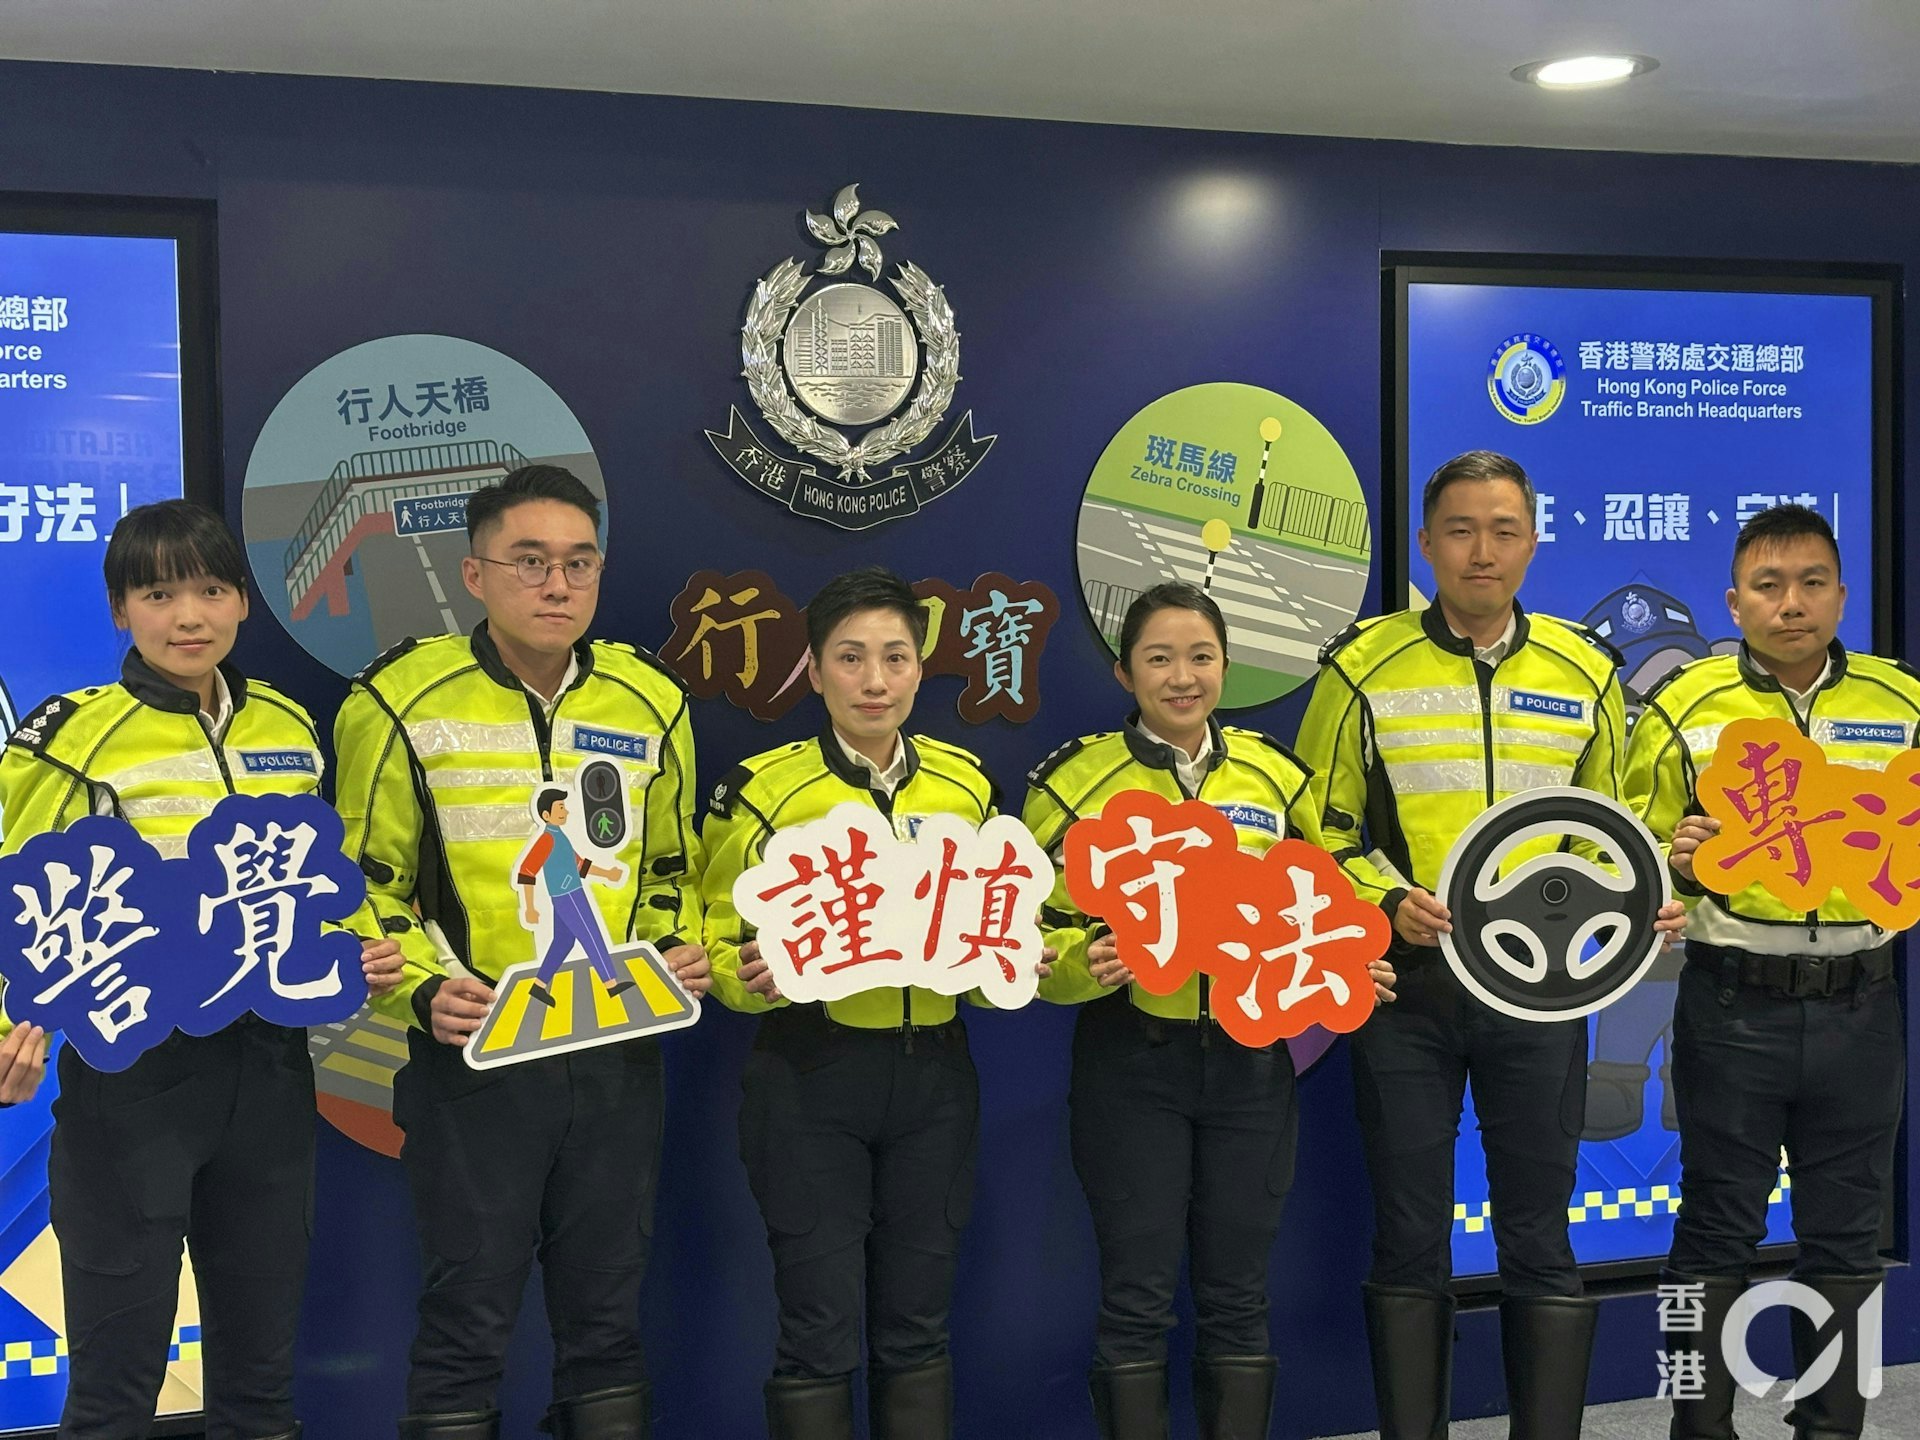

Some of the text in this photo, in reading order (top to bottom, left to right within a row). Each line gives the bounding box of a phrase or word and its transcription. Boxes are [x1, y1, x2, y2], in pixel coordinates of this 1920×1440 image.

[0, 343, 43, 361] rce
[1578, 340, 1805, 373] 香港警務處交通總部
[336, 375, 490, 425] 行人天橋
[1597, 377, 1787, 399] Hong Kong Police Force
[1581, 400, 1802, 422] Traffic Branch Headquarters
[368, 419, 467, 442] Footbridge
[734, 443, 787, 491] 香港
[1144, 434, 1238, 485] 斑馬線
[804, 484, 907, 514] HONG KONG POLICE
[1130, 465, 1241, 508] Zebra Crossing
[414, 498, 470, 511] Footbridge
[1526, 697, 1567, 713] POLICE
[590, 735, 631, 752] POLICE
[258, 755, 302, 767] POLICE
[1229, 809, 1267, 825] POLICE
[757, 826, 1034, 985] 謹慎
[1089, 815, 1367, 1021] 守法
[12, 821, 342, 1045] 警覺
